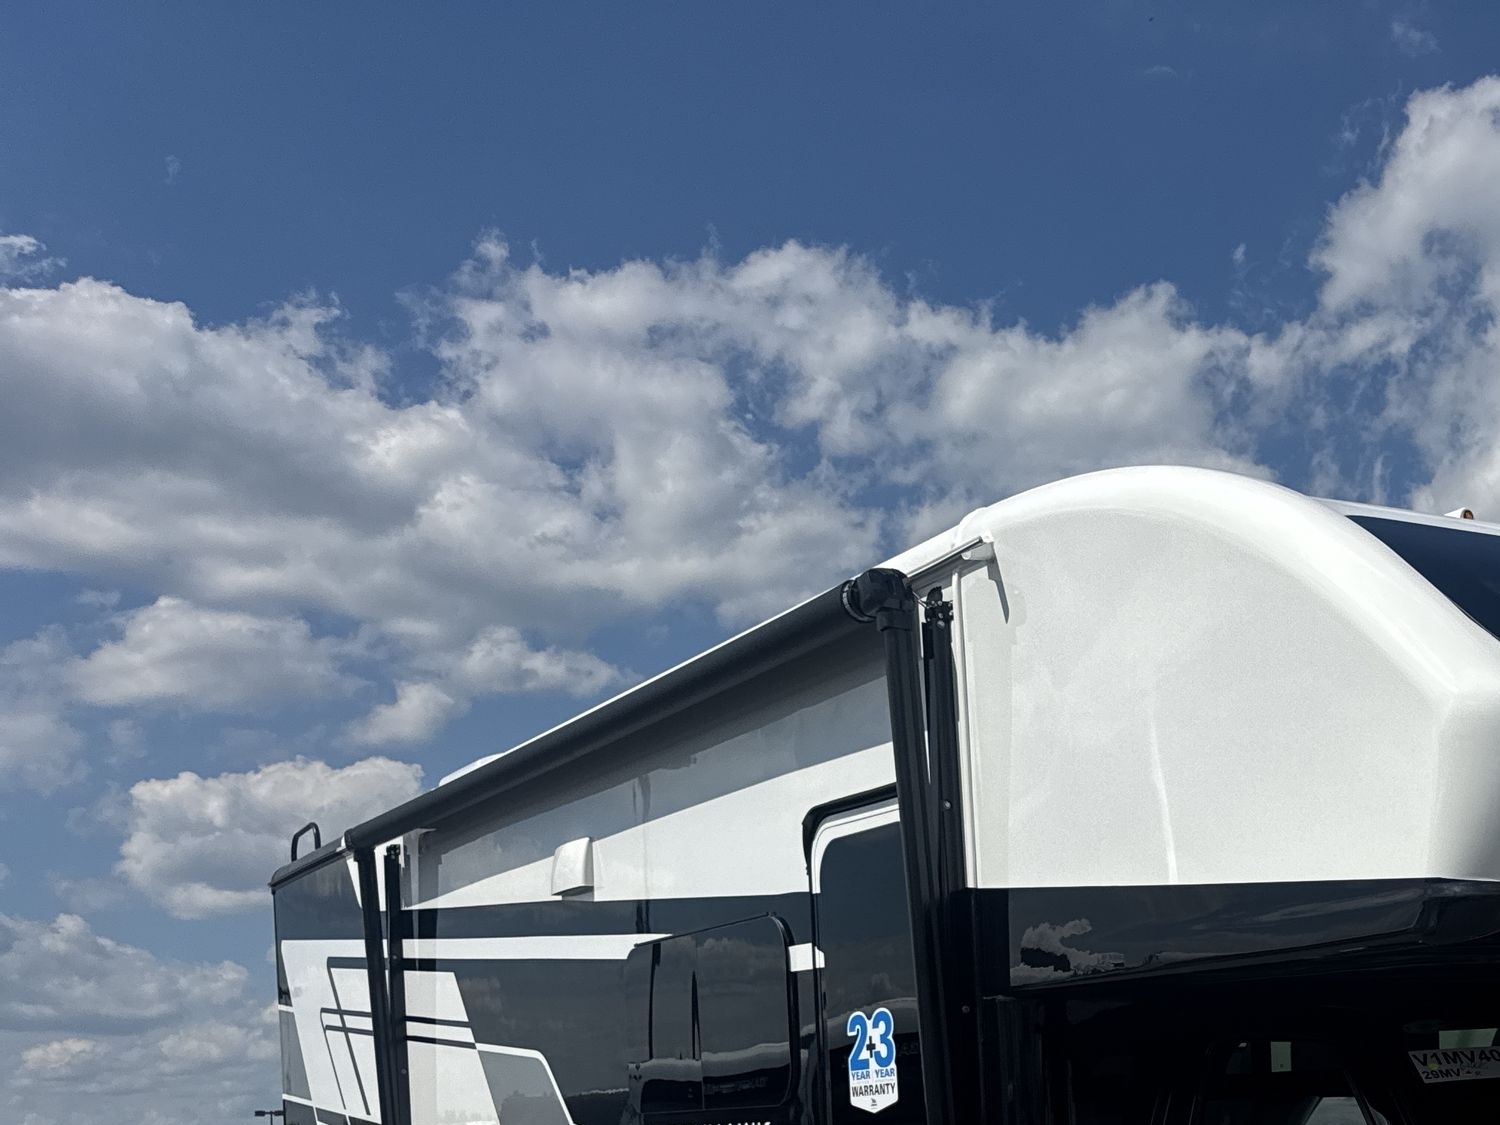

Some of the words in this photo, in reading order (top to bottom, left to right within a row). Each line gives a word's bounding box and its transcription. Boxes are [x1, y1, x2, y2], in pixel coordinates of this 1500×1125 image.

[852, 1071, 871, 1081] YEAR
[875, 1068, 895, 1079] YEAR
[852, 1083, 896, 1098] WARRANTY
